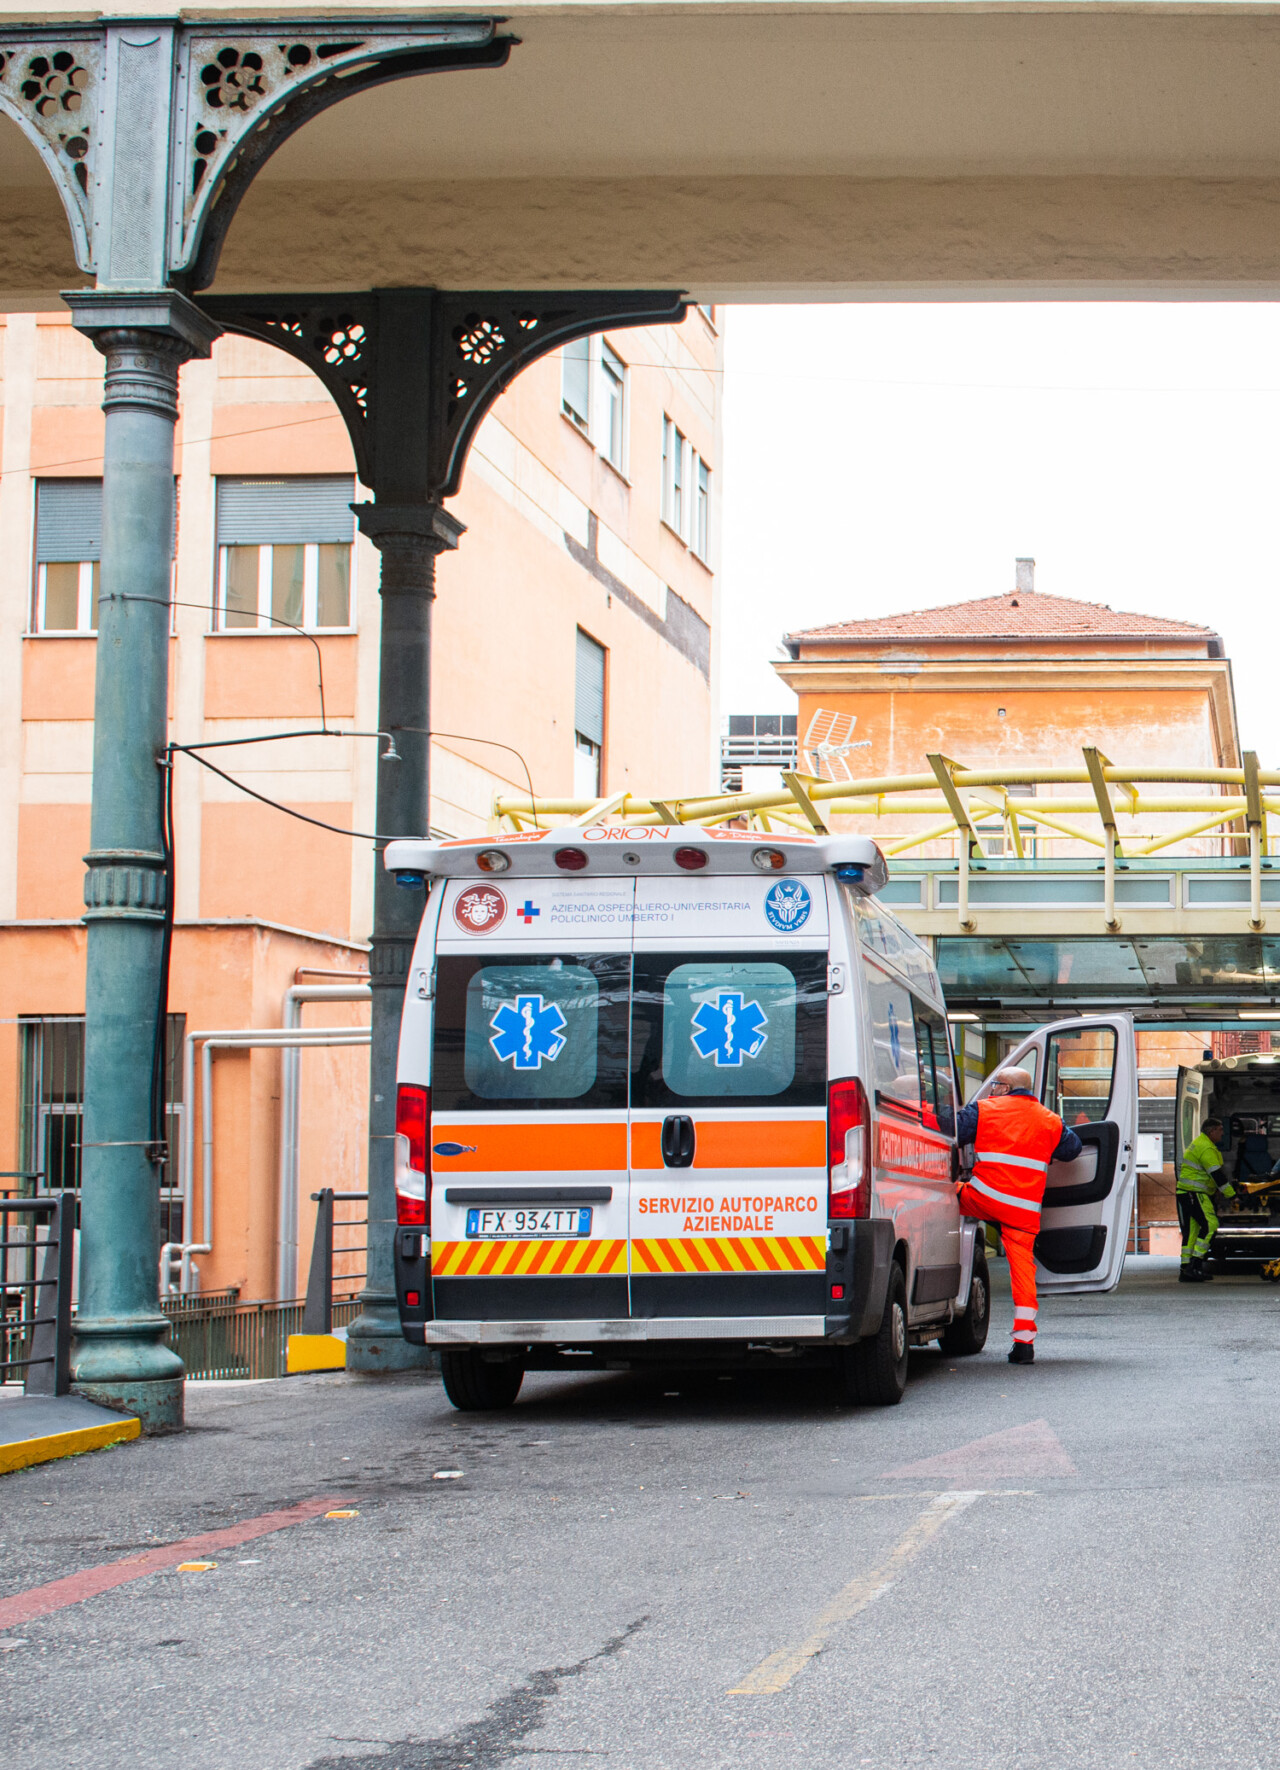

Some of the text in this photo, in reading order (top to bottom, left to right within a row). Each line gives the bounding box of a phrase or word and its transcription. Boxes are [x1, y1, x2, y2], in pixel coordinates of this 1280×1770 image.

[582, 827, 671, 841] ORION
[551, 902, 751, 913] AZIENDA OSPEDALIERO-UNIVERSITARIA
[550, 914, 616, 923] POLICLINICO
[618, 913, 669, 922] UMBERTO
[638, 1196, 818, 1214] SERVIZIO AUTOPARCO
[481, 1212, 506, 1231] FX
[515, 1211, 578, 1231] 934TT
[683, 1215, 774, 1232] AZIENDALE
